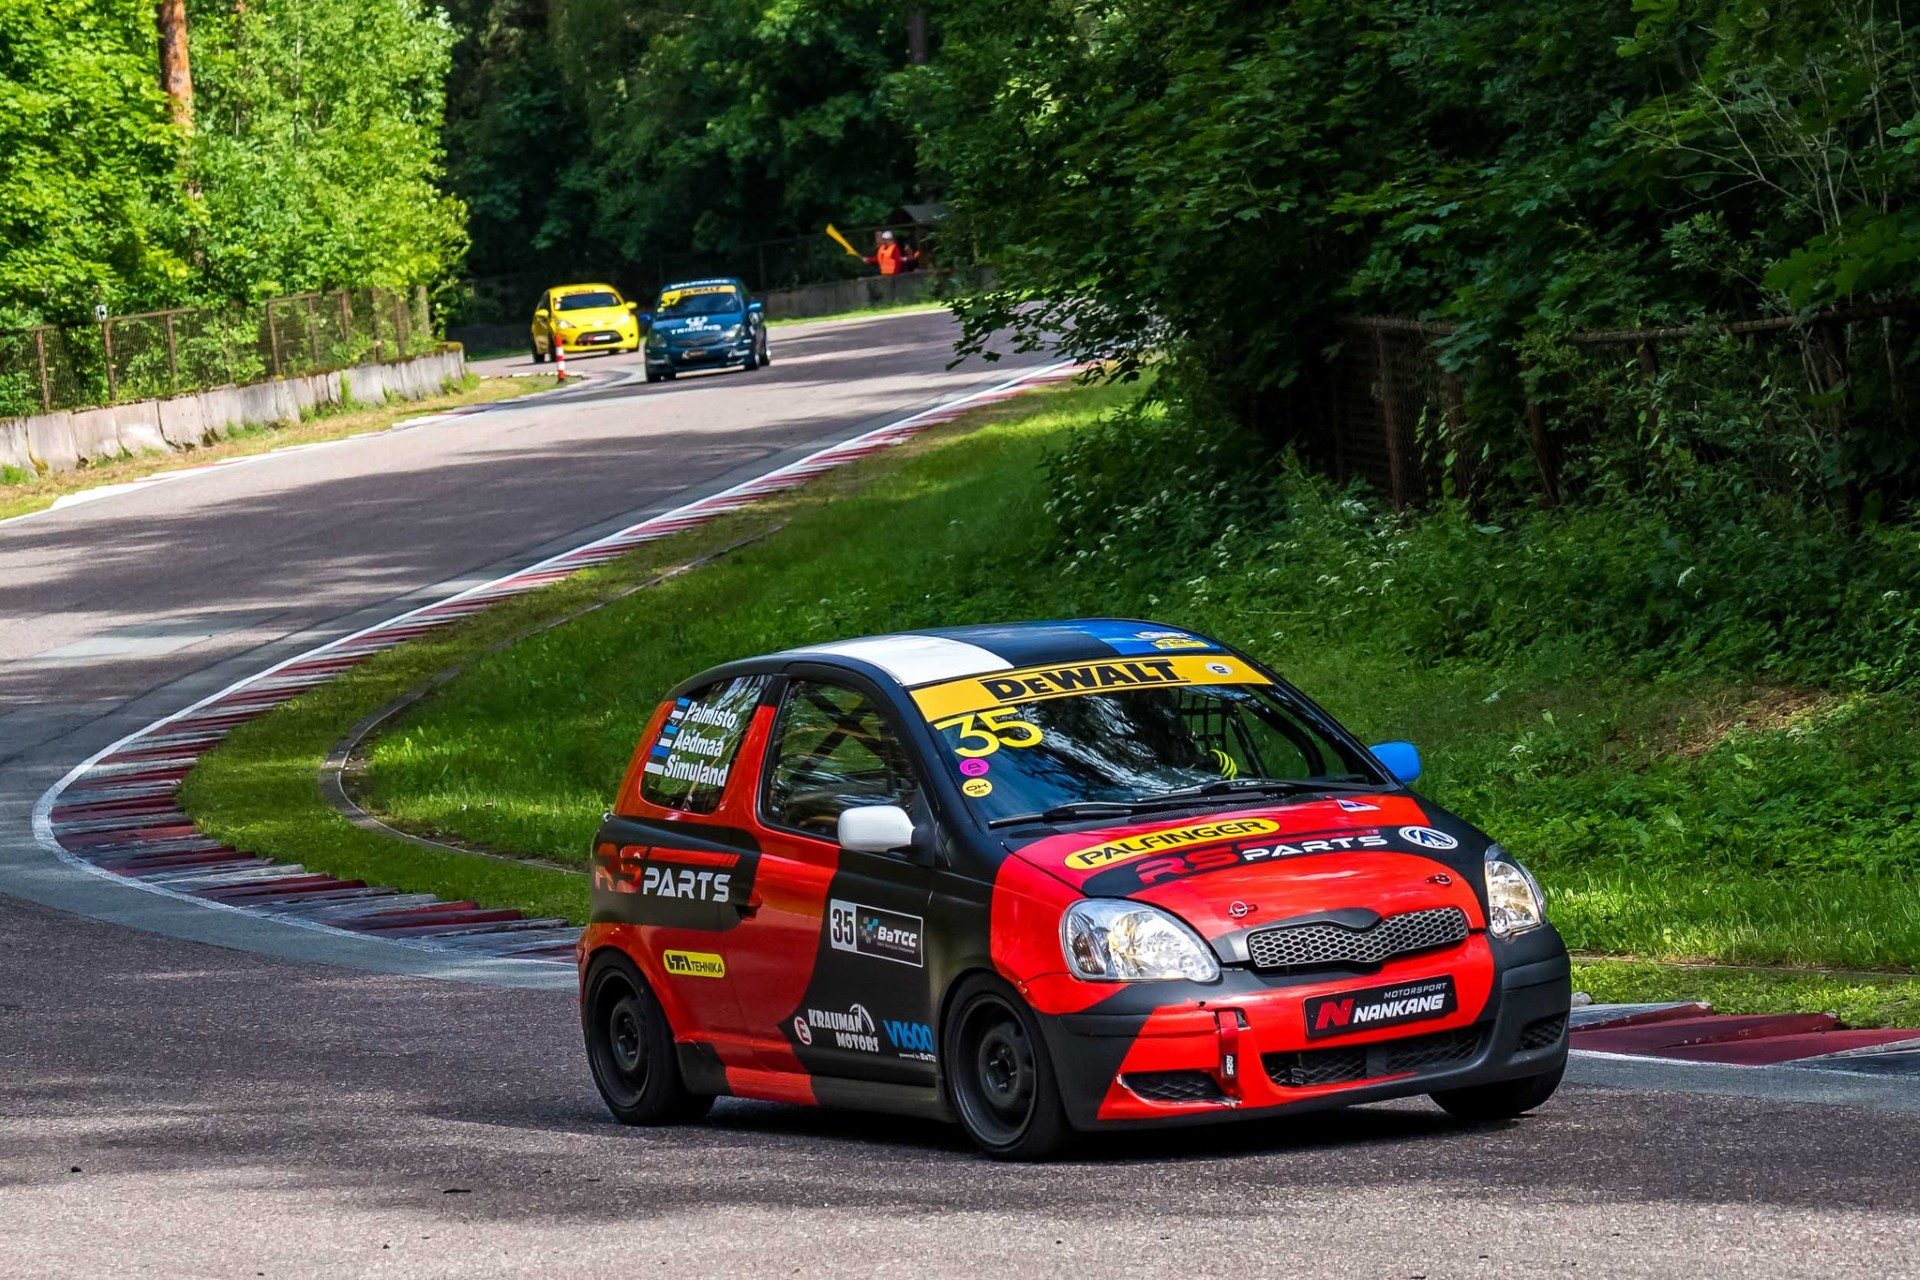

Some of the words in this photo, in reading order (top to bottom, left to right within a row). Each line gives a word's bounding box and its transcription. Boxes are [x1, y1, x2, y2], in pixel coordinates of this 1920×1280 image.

[684, 701, 737, 729] Palmisto
[672, 729, 724, 757] Aedmaa
[933, 706, 1043, 758] 35
[664, 754, 729, 787] Simuland
[1078, 820, 1268, 866] PALFINGER
[595, 843, 647, 894] RS
[643, 867, 731, 903] PARTS
[1135, 844, 1240, 885] RS
[1243, 834, 1388, 862] PARTS
[832, 908, 854, 945] 35
[877, 926, 917, 948] BaTCC
[691, 961, 724, 974] TEHNIKA
[1383, 982, 1447, 1000] MOTORSPORT
[808, 1008, 863, 1033] KRAUMAN
[1353, 993, 1445, 1024] NANKANG
[836, 1031, 879, 1053] MOTORS
